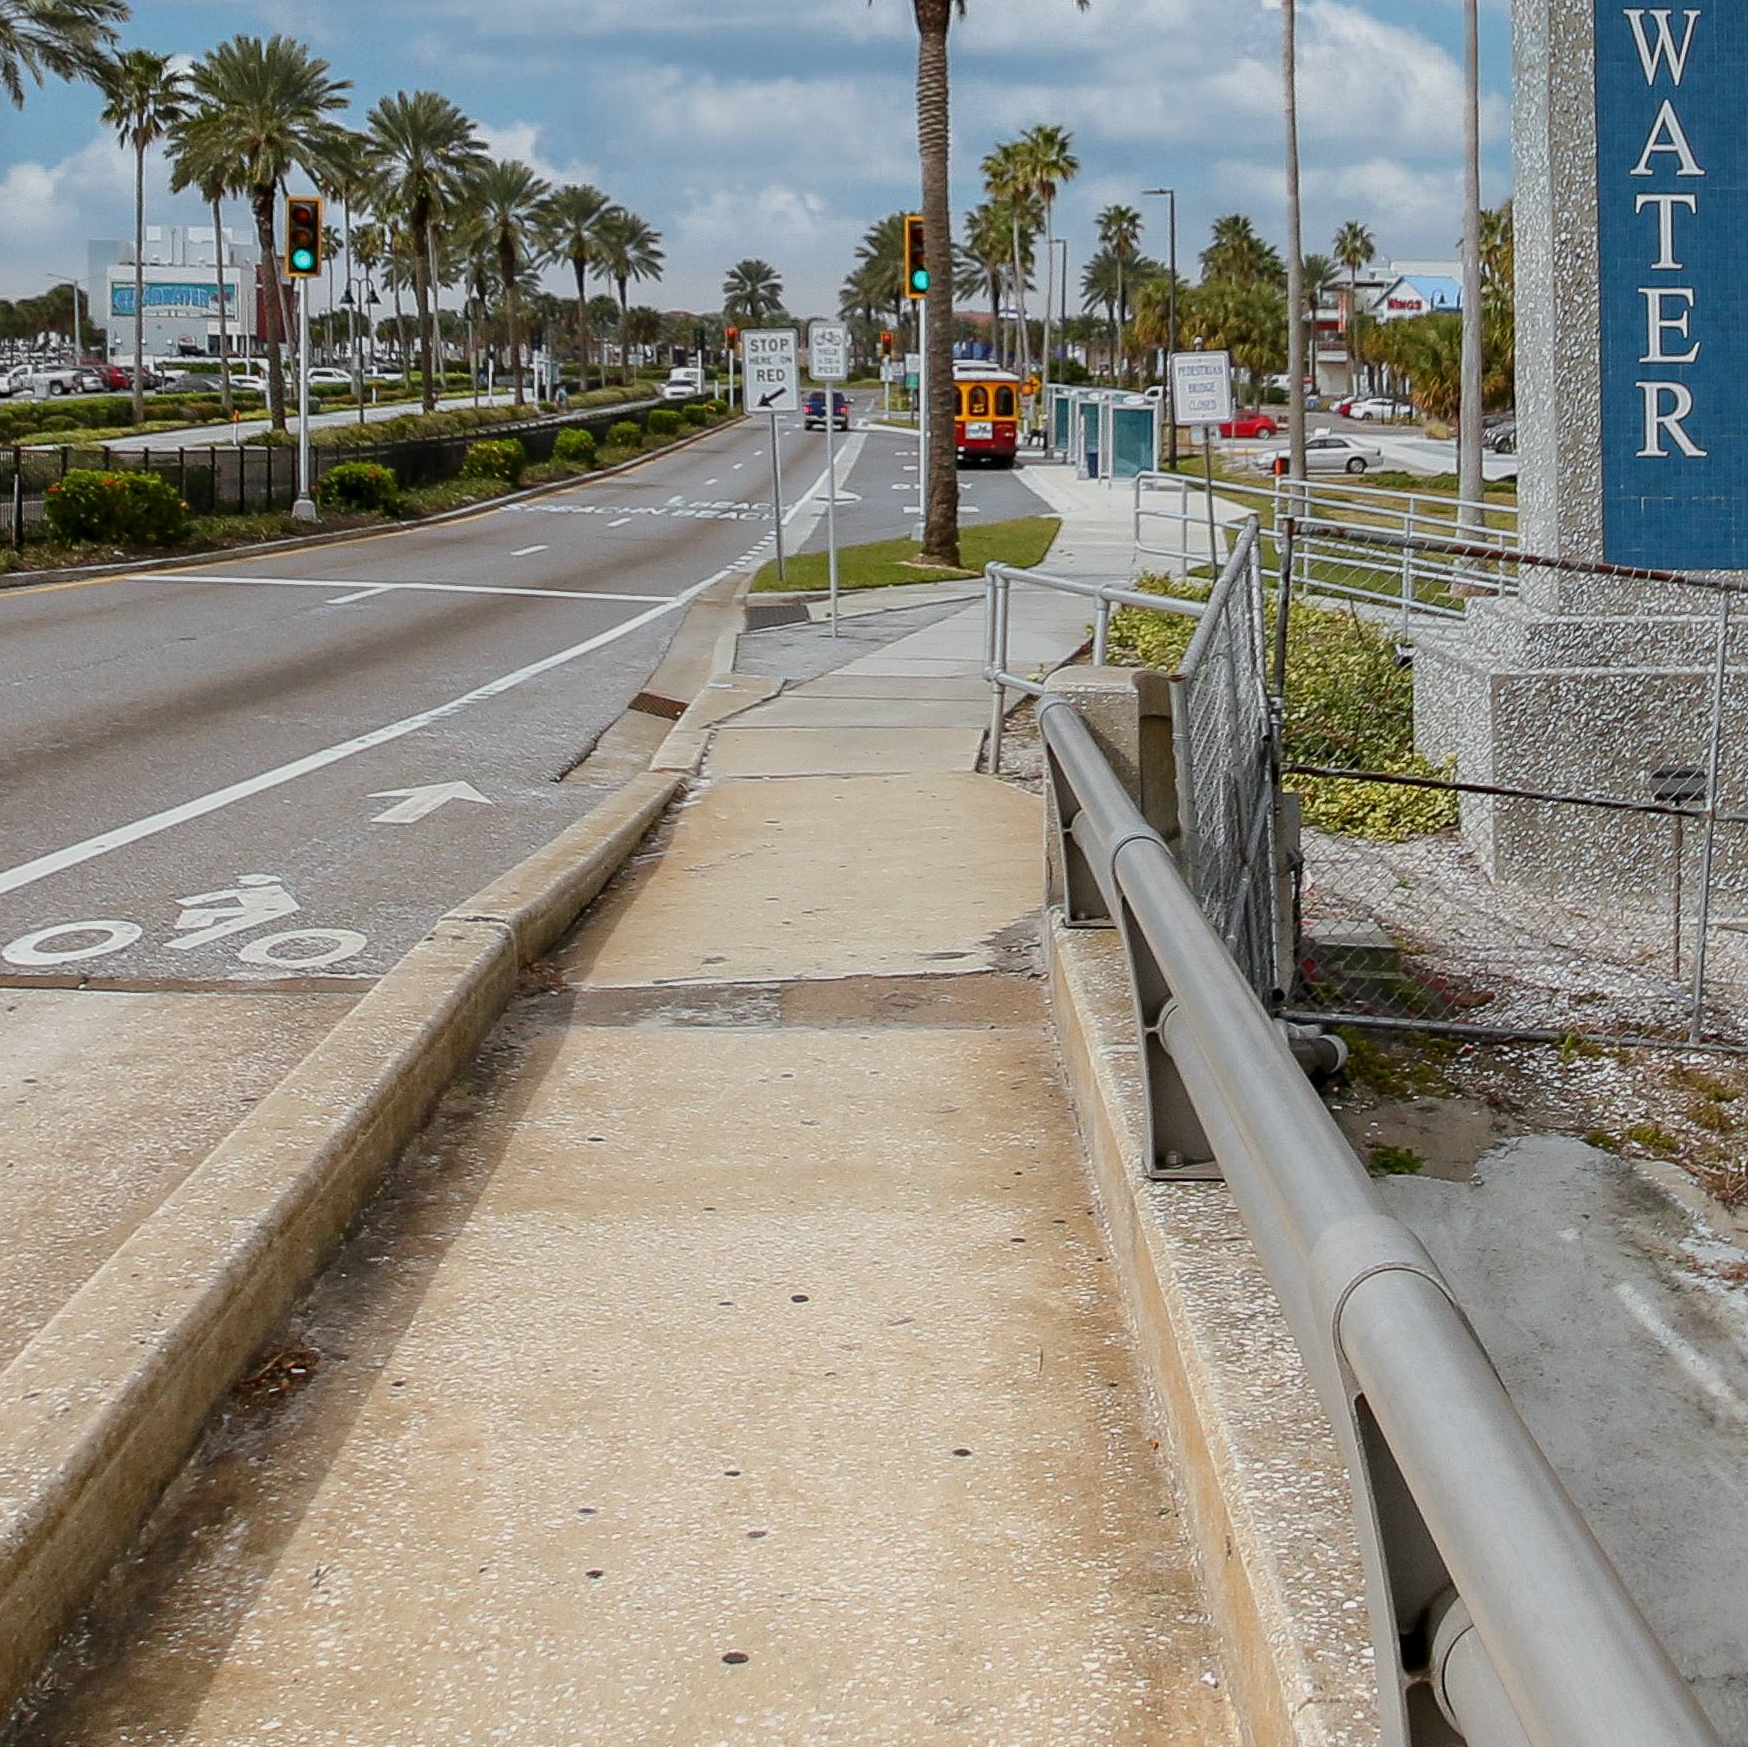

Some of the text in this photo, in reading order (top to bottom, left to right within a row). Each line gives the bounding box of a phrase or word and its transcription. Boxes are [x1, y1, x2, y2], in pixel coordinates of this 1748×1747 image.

[750, 338, 788, 352] STOP
[748, 355, 792, 365] HERE ON
[756, 368, 785, 382] RED
